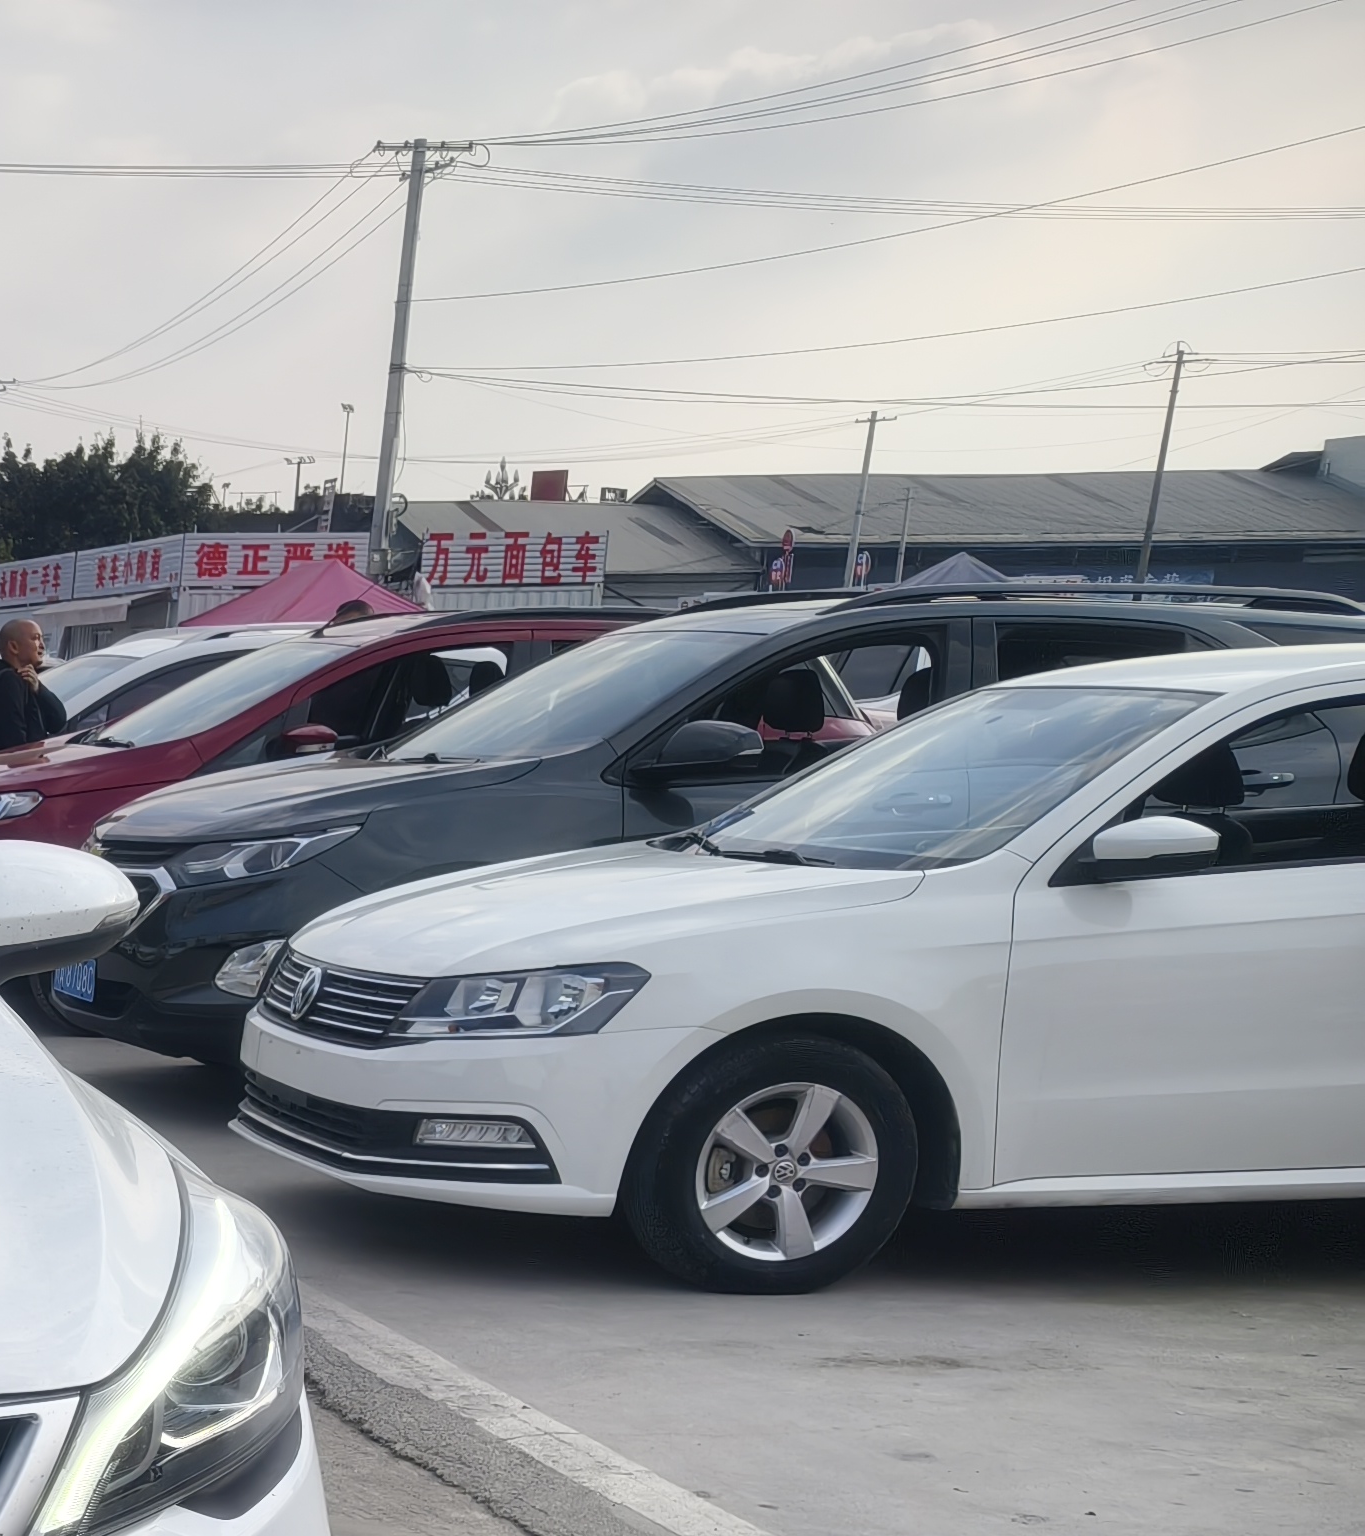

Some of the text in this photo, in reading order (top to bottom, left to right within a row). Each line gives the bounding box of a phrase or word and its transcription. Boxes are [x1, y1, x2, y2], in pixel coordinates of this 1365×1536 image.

[427, 531, 599, 585] 万元面包车
